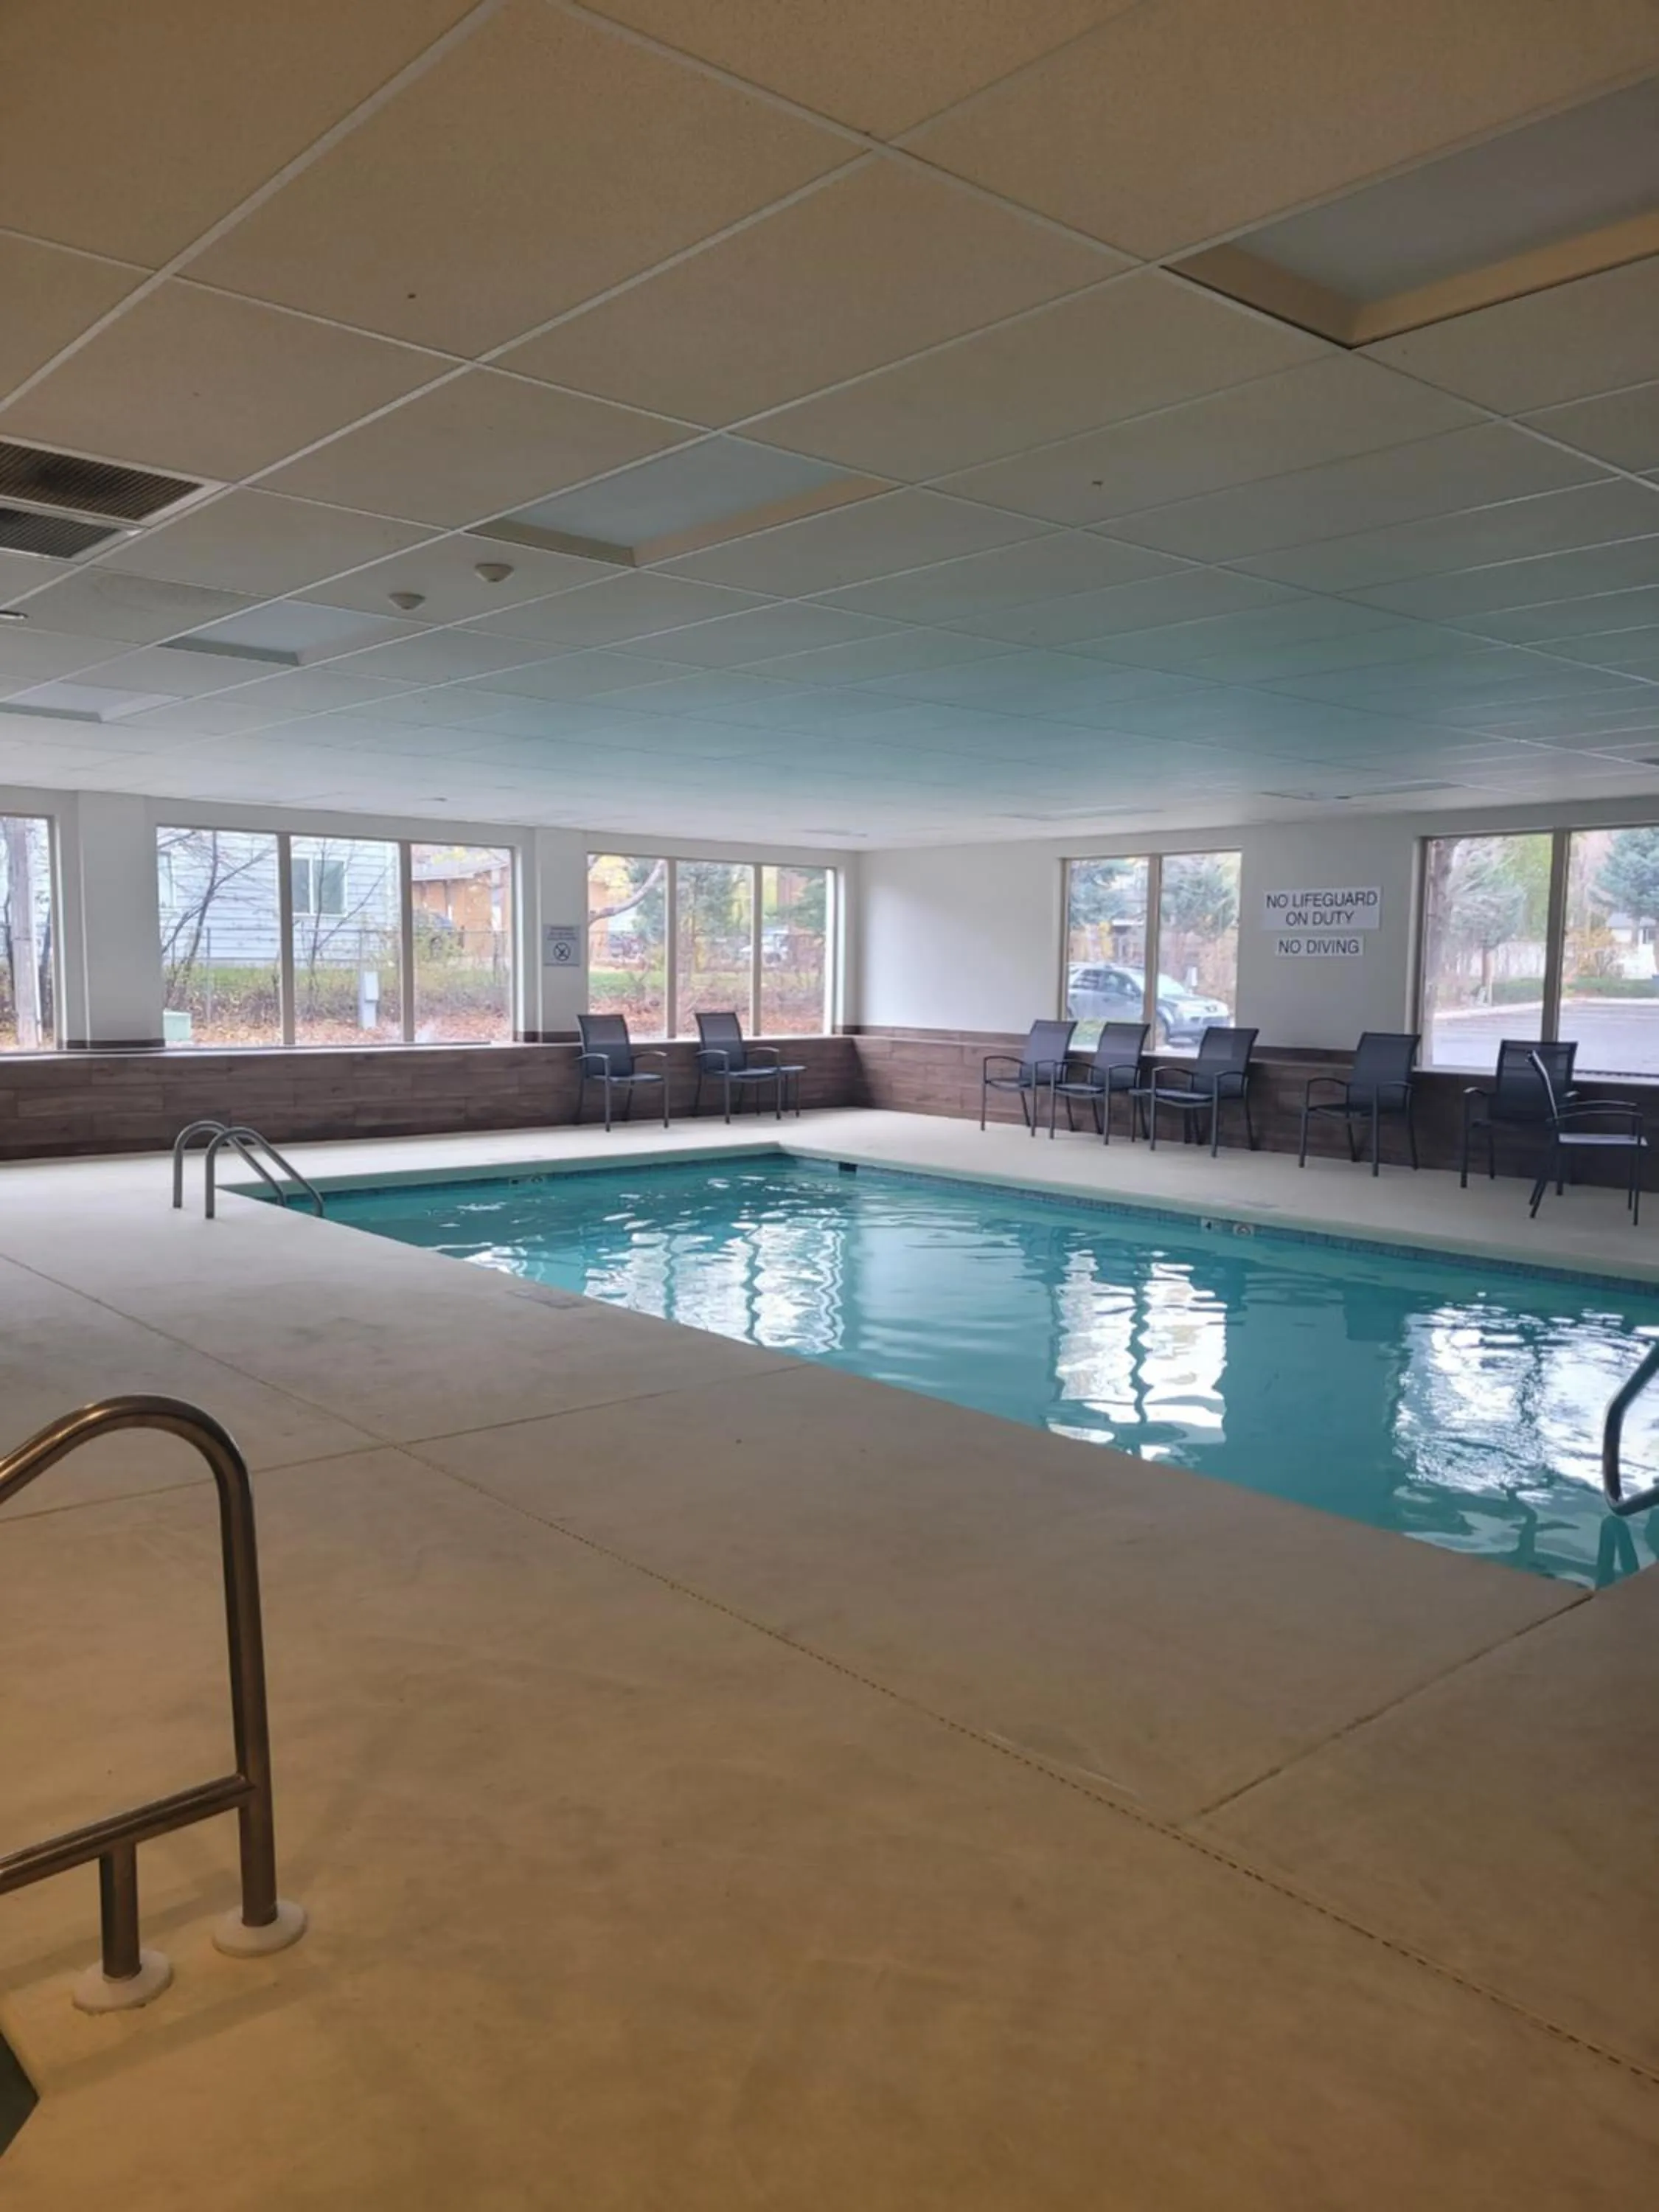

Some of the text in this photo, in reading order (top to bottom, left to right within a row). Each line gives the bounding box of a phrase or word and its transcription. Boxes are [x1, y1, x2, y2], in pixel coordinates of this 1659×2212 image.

[1266, 891, 1378, 908] NO LIFEGUARD
[1285, 911, 1354, 926] ON DUTY
[1278, 939, 1359, 954] NO DIVING
